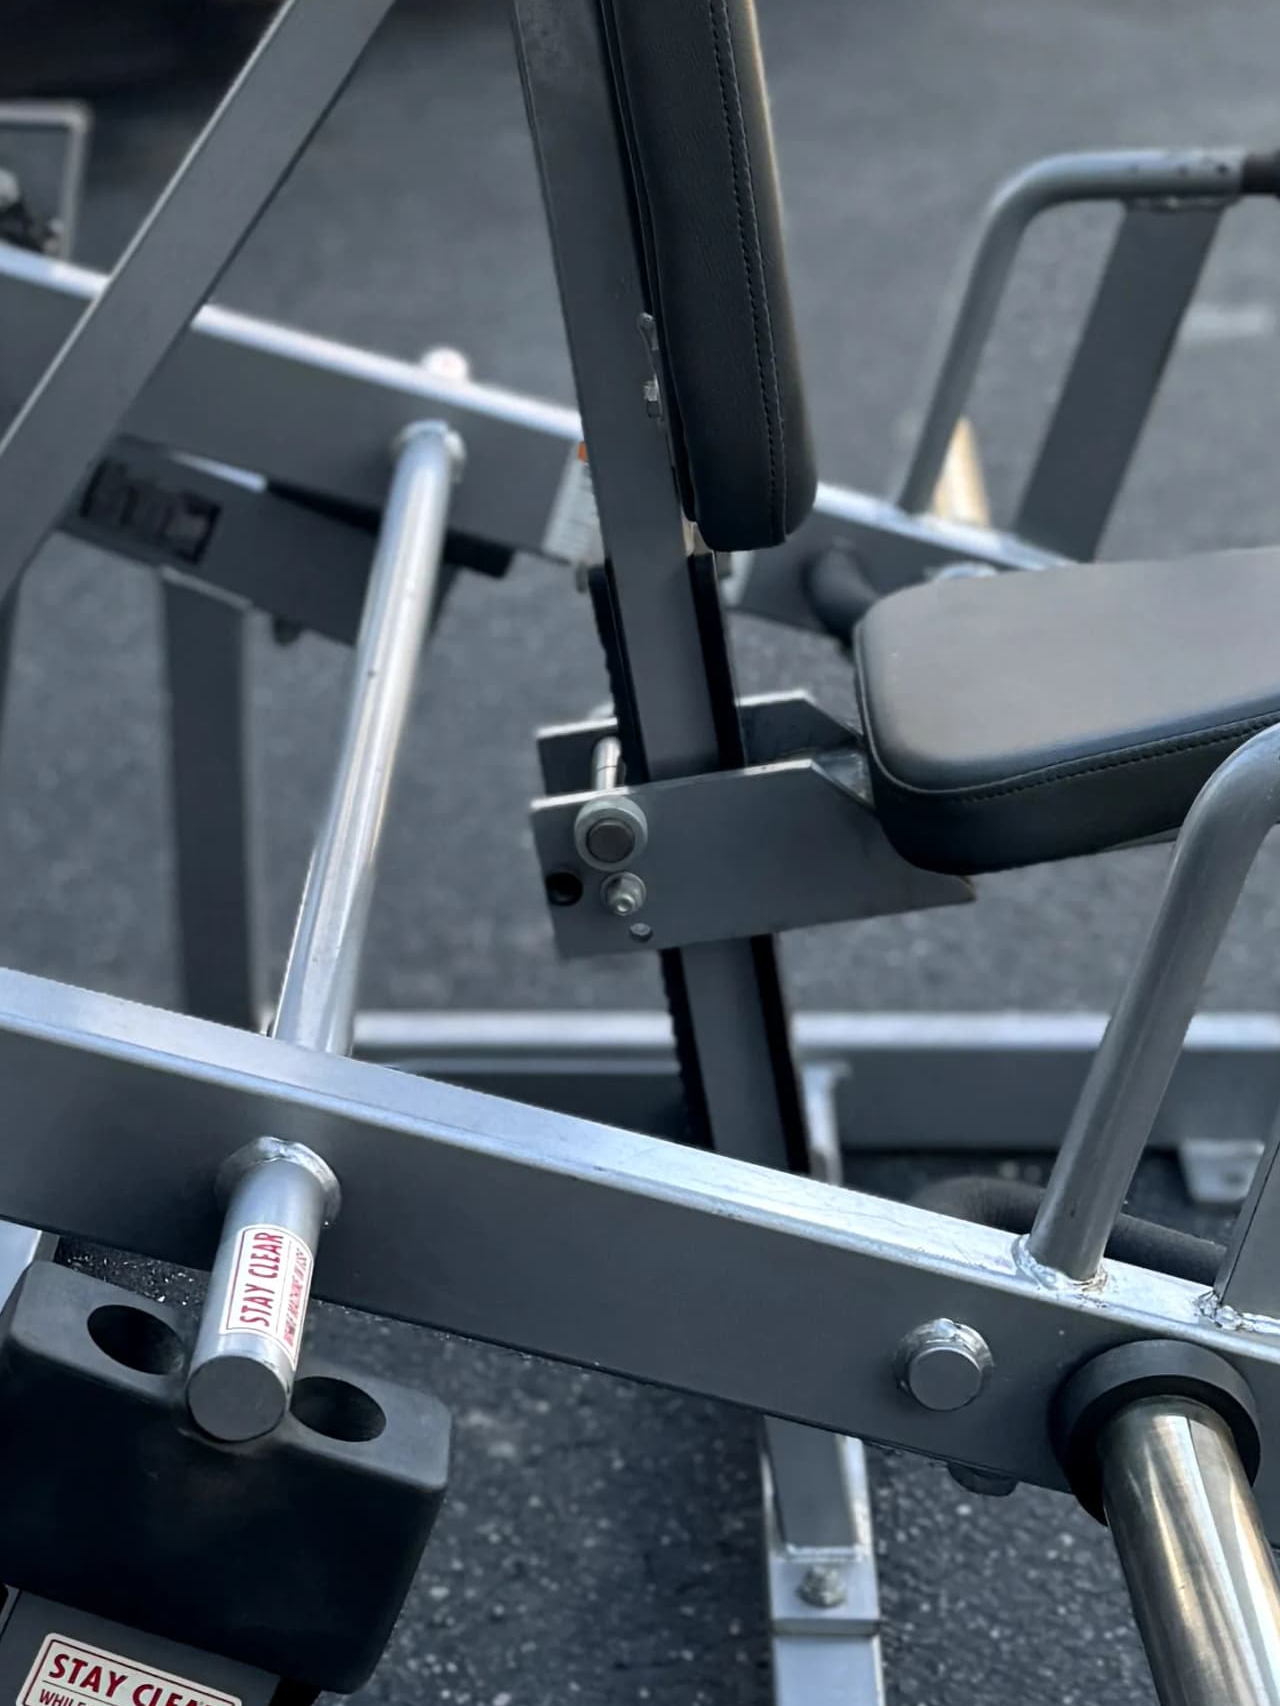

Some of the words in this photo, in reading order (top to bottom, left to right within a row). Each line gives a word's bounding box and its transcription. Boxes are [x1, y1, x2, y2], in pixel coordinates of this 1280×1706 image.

[248, 1232, 284, 1278] CLEAR
[240, 1284, 275, 1327] STAY
[48, 1653, 127, 1698] STAY
